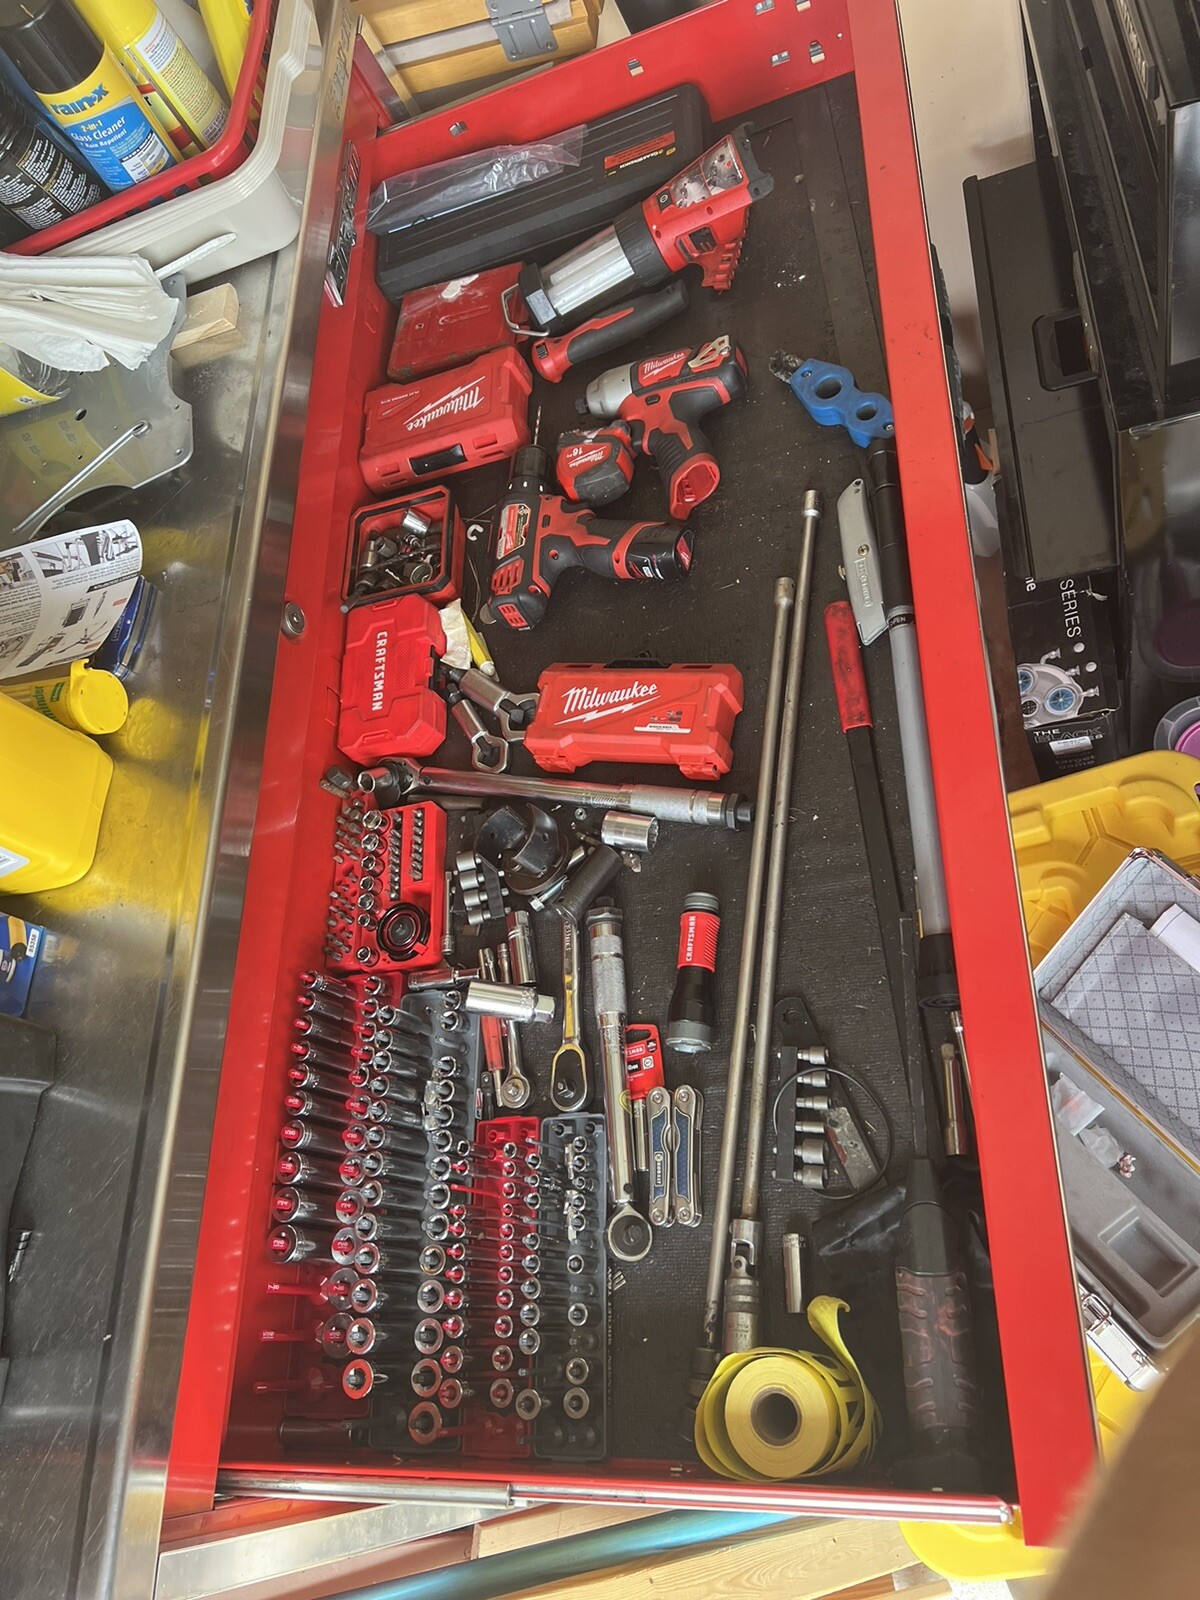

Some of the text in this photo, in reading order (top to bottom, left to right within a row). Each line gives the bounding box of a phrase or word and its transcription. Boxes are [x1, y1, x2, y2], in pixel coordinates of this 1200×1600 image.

[92, 116, 126, 141] Cleaner
[99, 129, 128, 147] Repellent
[642, 352, 684, 375] Milwaukee
[405, 386, 485, 432] Milwaukee
[568, 450, 604, 469] Milwaukee
[1060, 578, 1082, 638] SERIES
[371, 631, 388, 713] CRAFTSMAN
[560, 680, 659, 715] Milwaukee
[1034, 728, 1060, 736] THE
[685, 915, 698, 962] CRAFTSMAN
[653, 1161, 662, 1185] KOBALT
